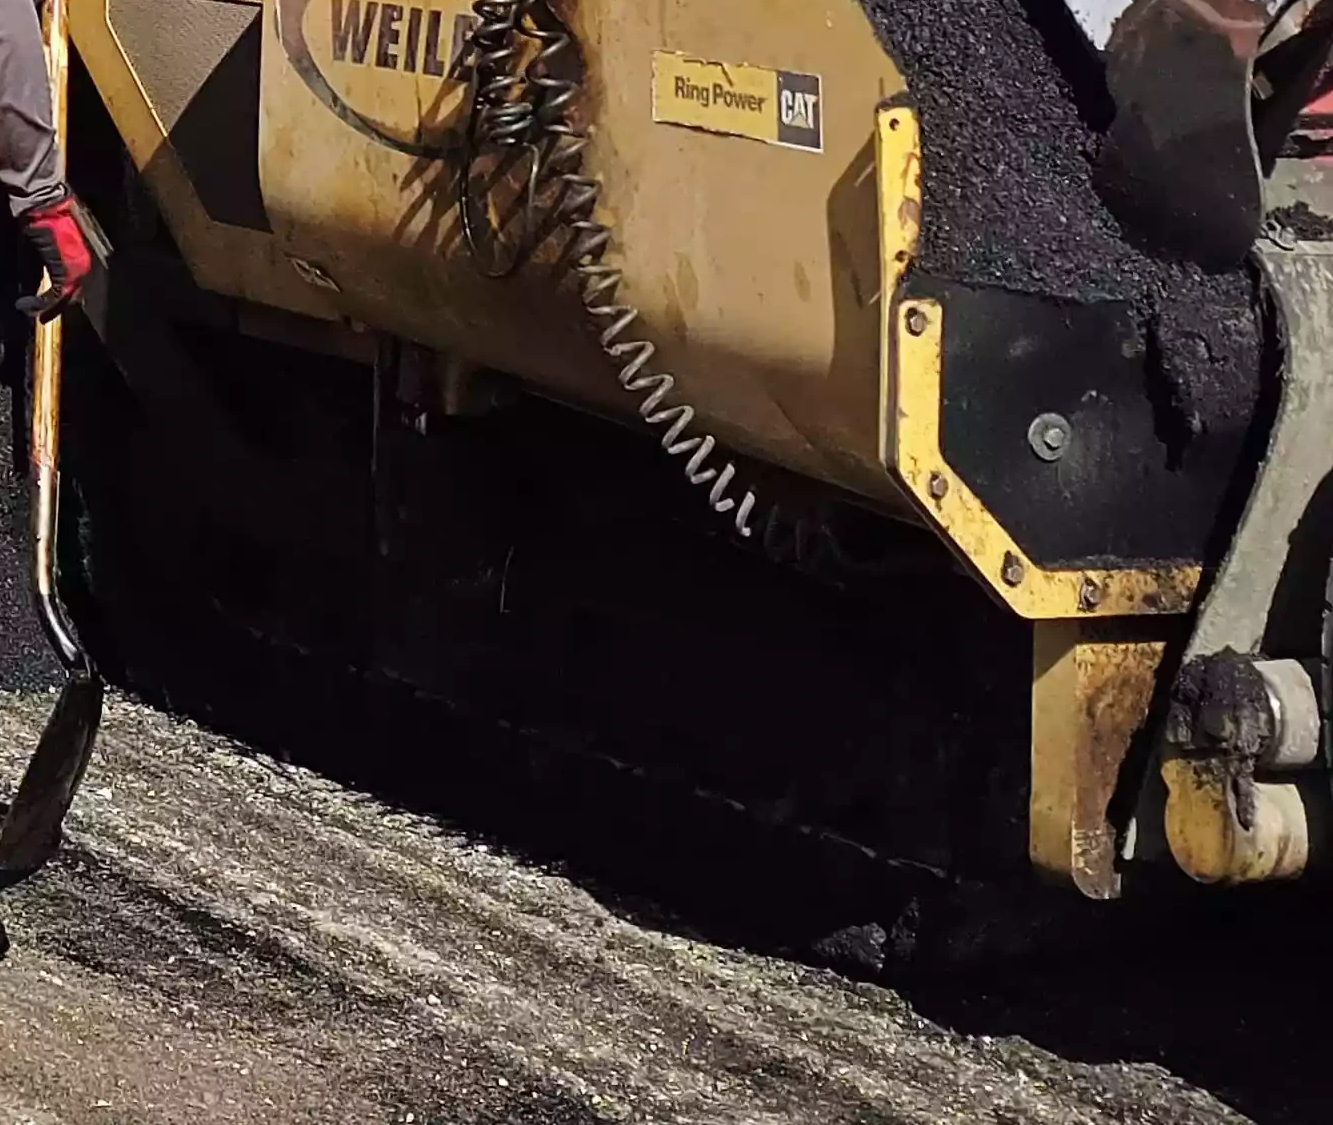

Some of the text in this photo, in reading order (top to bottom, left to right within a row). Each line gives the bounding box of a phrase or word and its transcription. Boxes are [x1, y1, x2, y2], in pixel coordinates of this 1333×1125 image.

[674, 75, 769, 114] Ring Power
[780, 88, 818, 129] CAT
